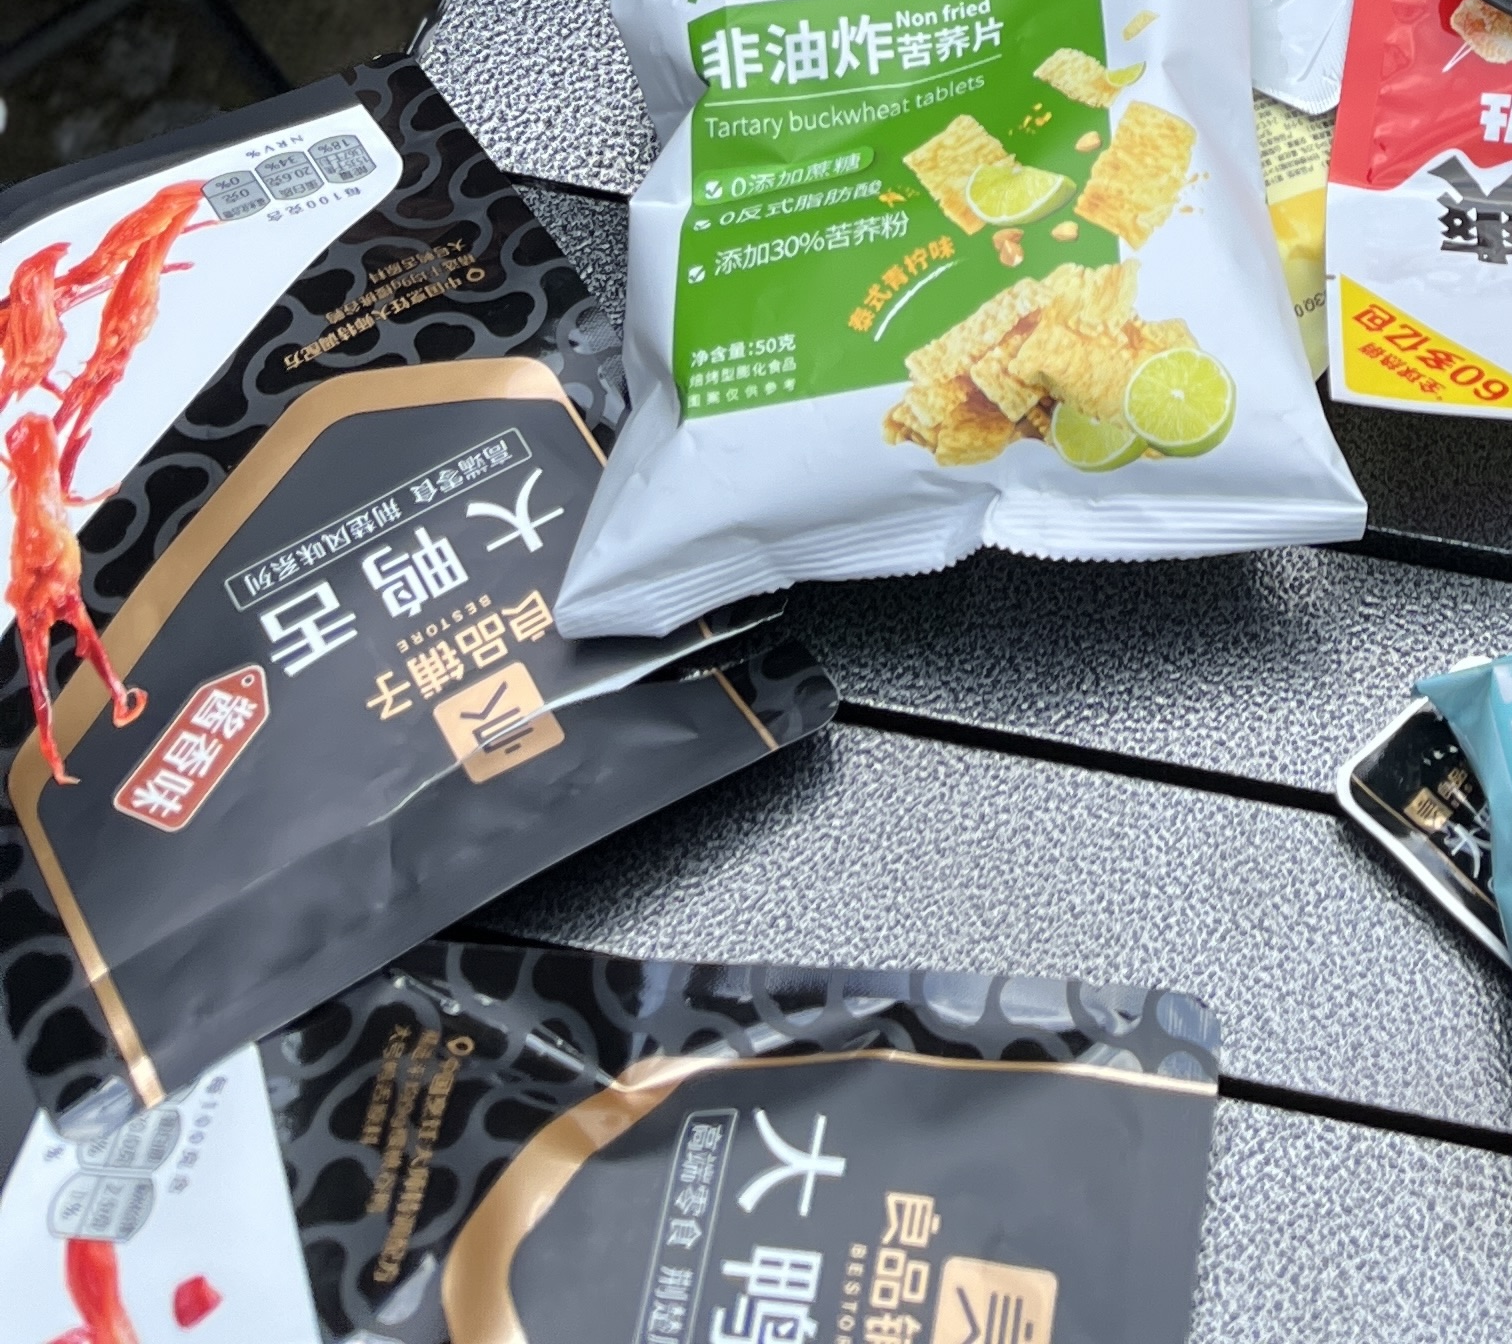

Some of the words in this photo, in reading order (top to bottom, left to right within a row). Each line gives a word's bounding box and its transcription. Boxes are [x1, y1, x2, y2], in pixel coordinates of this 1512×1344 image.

[896, 10, 938, 28] Non
[898, 18, 1004, 70] 苦荞片
[702, 15, 894, 90] 非油炸
[705, 114, 782, 139] Tartary
[789, 98, 910, 132] buckwheat
[916, 76, 985, 107] tablets
[264, 155, 296, 172] 34%
[318, 138, 351, 155] 18%
[266, 186, 362, 223] 每100克含
[715, 211, 909, 276] 添加30%苦荞粉
[1351, 302, 1512, 403] 60多亿包
[409, 439, 514, 507] 高端零食
[242, 498, 403, 596] 荆楚风味系列
[259, 468, 565, 677] 大鸭舌
[366, 589, 556, 723] 良品铺子
[395, 593, 493, 654] BESTORE
[129, 686, 258, 822] 酱香味
